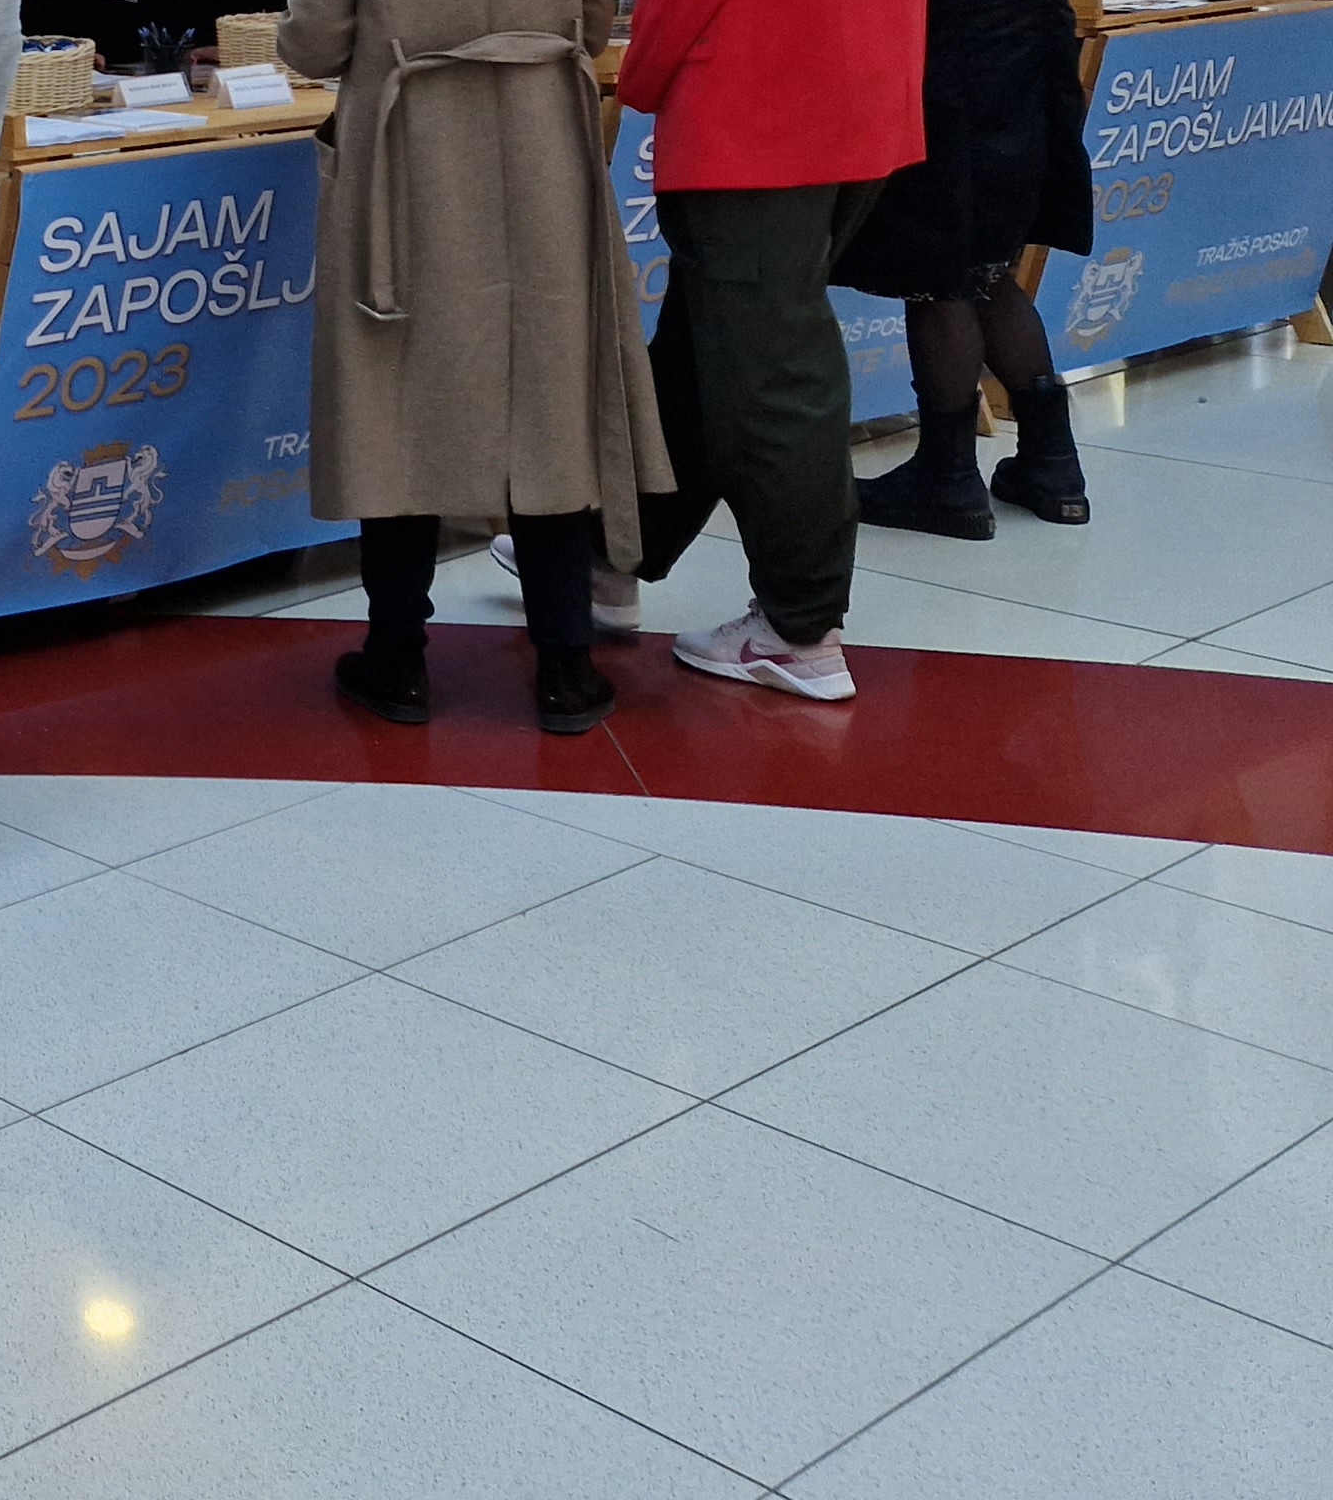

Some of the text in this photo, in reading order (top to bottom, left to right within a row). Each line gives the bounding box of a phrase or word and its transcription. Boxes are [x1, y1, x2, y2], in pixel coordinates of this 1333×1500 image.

[1106, 55, 1236, 116] SAJAM
[39, 189, 275, 274] SAJAM
[13, 342, 193, 423] 2023
